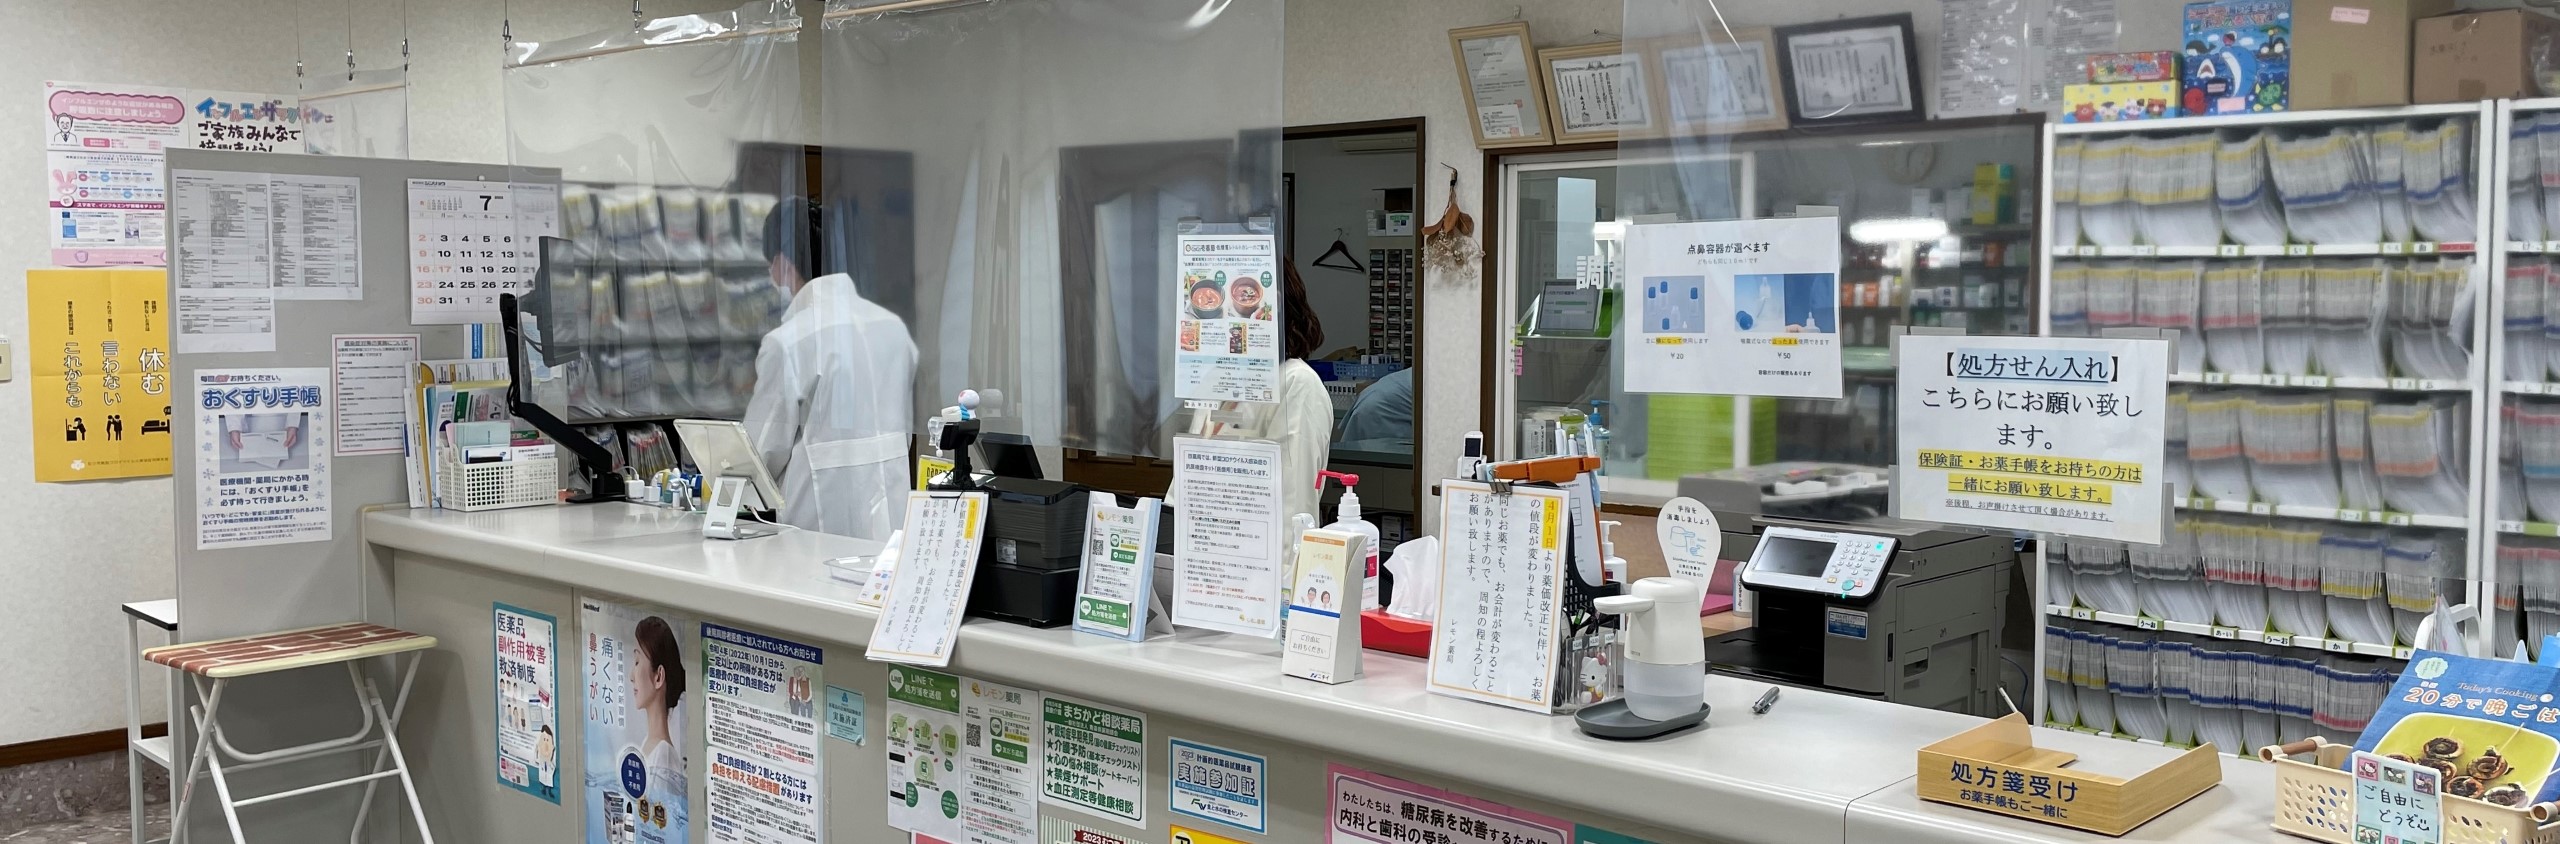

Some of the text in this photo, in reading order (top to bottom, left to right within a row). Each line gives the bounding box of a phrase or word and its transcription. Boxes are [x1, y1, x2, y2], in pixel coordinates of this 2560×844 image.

[198, 120, 301, 142] ご家族みんなで
[479, 195, 492, 211] 7
[1688, 242, 1771, 255] 点鼻容器が選べます
[64, 342, 82, 407] これからも
[101, 341, 121, 406] 言わない
[139, 348, 165, 395] 休む
[1758, 369, 1812, 377] 容器だけの販売もあります
[1946, 352, 2119, 382] 【処方せん入れ】
[202, 386, 321, 409] おくすり手帳
[1922, 386, 2143, 417] こちらにお願い致し
[1997, 424, 2053, 450] ます。
[1918, 452, 2142, 481] 保険証・お薬手帳をお持ちの方は
[219, 474, 310, 487] 医療機関・薬局にかかる時
[220, 484, 310, 496] には、「おくすり手帳」を
[1948, 476, 2103, 503] 一緒にお願い致します。
[220, 495, 309, 507] 必ず持って行きましょう。
[1678, 505, 1697, 514] 手指を
[1666, 513, 1710, 526] 消毒しましょう
[913, 499, 931, 570] お願い致します。
[1466, 493, 1479, 582] お願い致します。
[1523, 498, 1542, 628] の値段が変わりました。
[1471, 493, 1494, 690] がありますので、周知の程よろしく
[1485, 494, 1509, 692] 同じお薬でも、お会計が変わること
[1530, 500, 1557, 702] 4月1日より薬価改正に伴い、お薬
[498, 613, 524, 635] 医薬品
[498, 635, 547, 665] 副作用被害
[1292, 643, 1327, 655] お持ちください
[1300, 634, 1321, 644] ご自由に
[1446, 618, 1457, 665] レモン薬局
[499, 656, 537, 685] 救済制度
[590, 633, 598, 720] 鼻うがい
[602, 637, 613, 724] 痛くない
[709, 656, 786, 683] 一定以上の所得がある方は、
[709, 667, 776, 693] 医療費の窓口負担割合が
[911, 674, 934, 686] LINEで
[709, 680, 742, 697] 変わります。
[904, 684, 942, 701] 処方箋を送信
[983, 685, 1021, 705] レモン薬局
[2457, 682, 2538, 702] Today's Cooking
[833, 711, 857, 726] 実施済証
[1064, 705, 1140, 734] まちかど相談薬局
[712, 763, 812, 804] 負担を抑える配慮措置があります
[1054, 767, 1104, 790] 禁煙サポート
[1178, 762, 1255, 797] 実施参加証
[1950, 760, 2079, 803] 処方箋受け
[1054, 782, 1134, 815] 血圧測定等健康相談
[1960, 788, 2068, 819] お薬手帳もご一緒に
[2364, 784, 2424, 810] ご自由に
[2378, 808, 2418, 829] どうぞ
